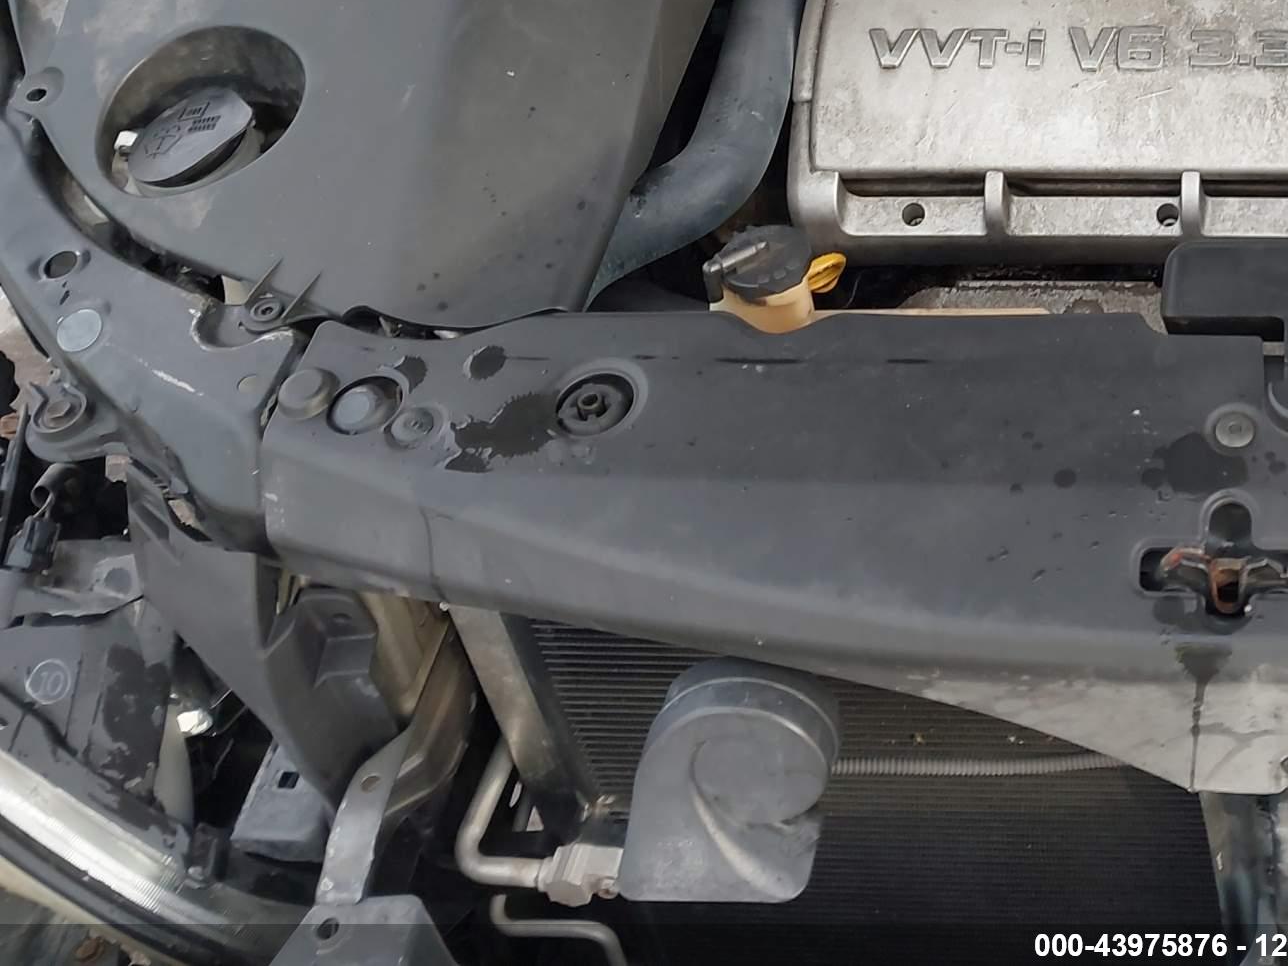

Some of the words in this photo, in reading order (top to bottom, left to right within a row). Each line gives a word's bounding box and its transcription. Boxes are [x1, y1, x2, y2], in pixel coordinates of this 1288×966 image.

[869, 27, 1046, 69] VVT-i
[1068, 25, 1166, 72] V6
[40, 670, 65, 696] 10
